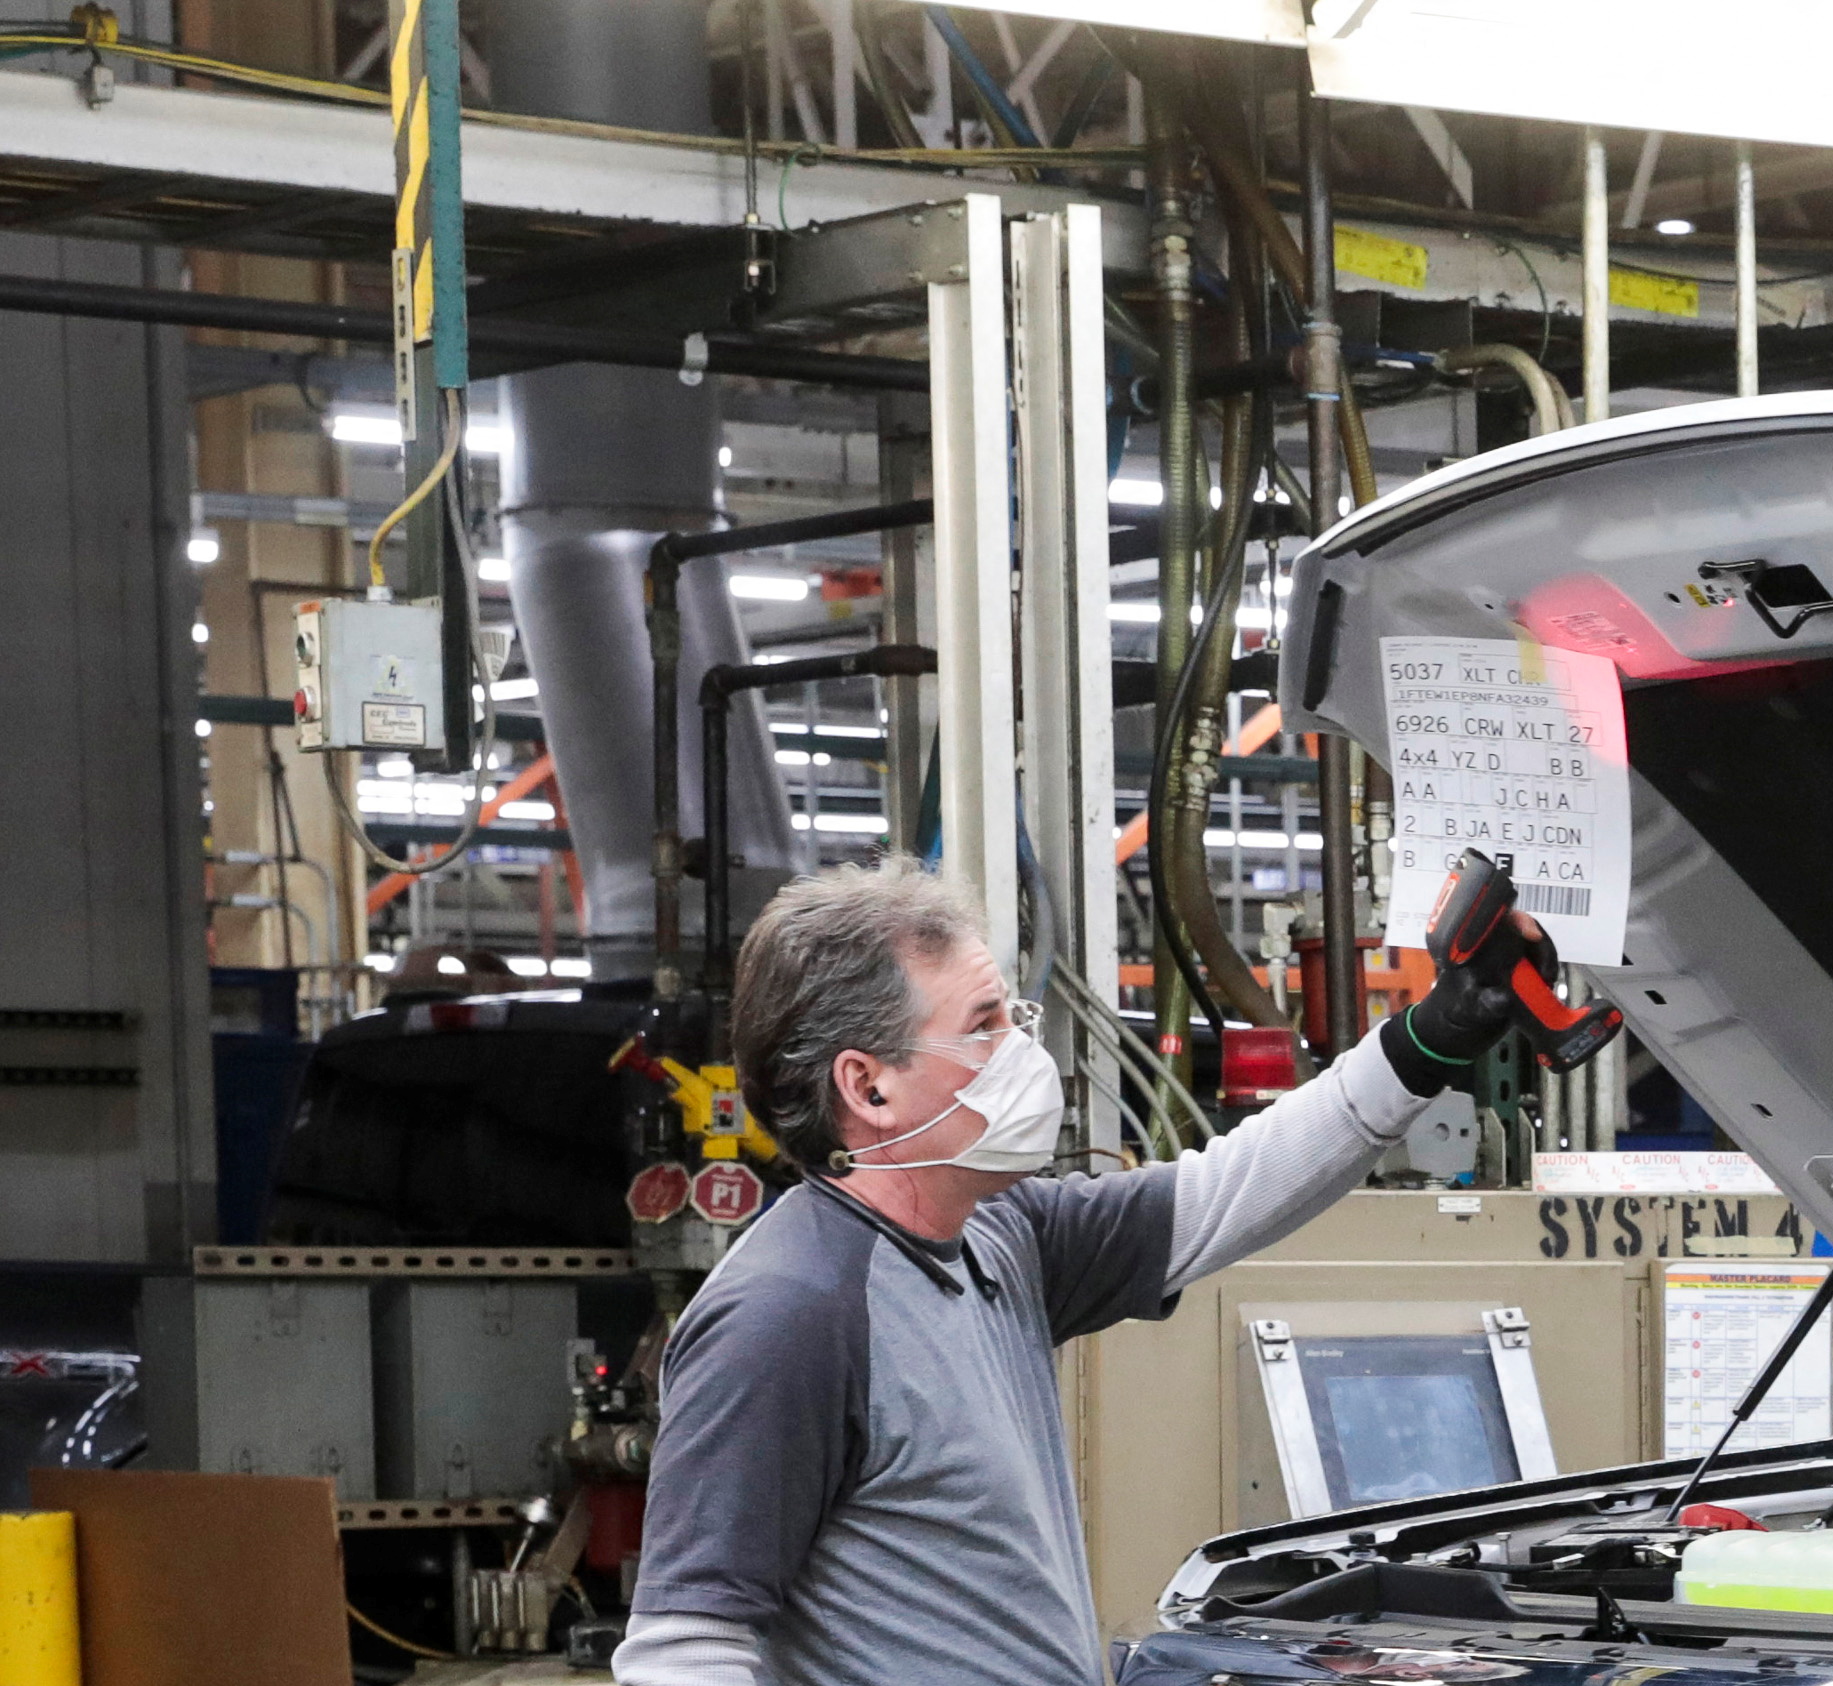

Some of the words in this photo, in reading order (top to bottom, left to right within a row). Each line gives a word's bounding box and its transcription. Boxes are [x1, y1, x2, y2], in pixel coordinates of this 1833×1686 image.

[1390, 662, 1443, 680] 5037
[1462, 667, 1496, 683] XLT
[1396, 714, 1449, 733] 6926
[1464, 717, 1504, 737] CRW
[1517, 721, 1556, 740] XLT
[1569, 725, 1594, 743] 27
[1399, 748, 1439, 766] 4x4
[1451, 751, 1477, 769] YZ
[1488, 753, 1500, 771] D
[1551, 758, 1563, 775] B
[1571, 760, 1584, 776] B
[1402, 782, 1416, 798] A
[1422, 783, 1437, 799] A
[1495, 788, 1508, 806] J
[1515, 789, 1528, 807] C
[1536, 791, 1548, 808] H
[1557, 793, 1571, 810] A
[1404, 815, 1416, 833] 2
[1446, 818, 1457, 836] B
[1465, 820, 1492, 838] JA
[1502, 823, 1514, 840] E
[1522, 824, 1535, 841] J
[1543, 826, 1582, 845] CDN
[1403, 850, 1416, 867] B
[1496, 856, 1510, 870] F
[1537, 861, 1550, 877] A
[1558, 862, 1584, 880] CA
[1537, 1154, 1588, 1166] CAUTION
[1622, 1153, 1681, 1165] CAUTION
[712, 1182, 741, 1208] P1
[1539, 1196, 1748, 1257] SYSTEM
[1710, 1274, 1746, 1283] MASTER
[1750, 1275, 1792, 1284] PLACARD
